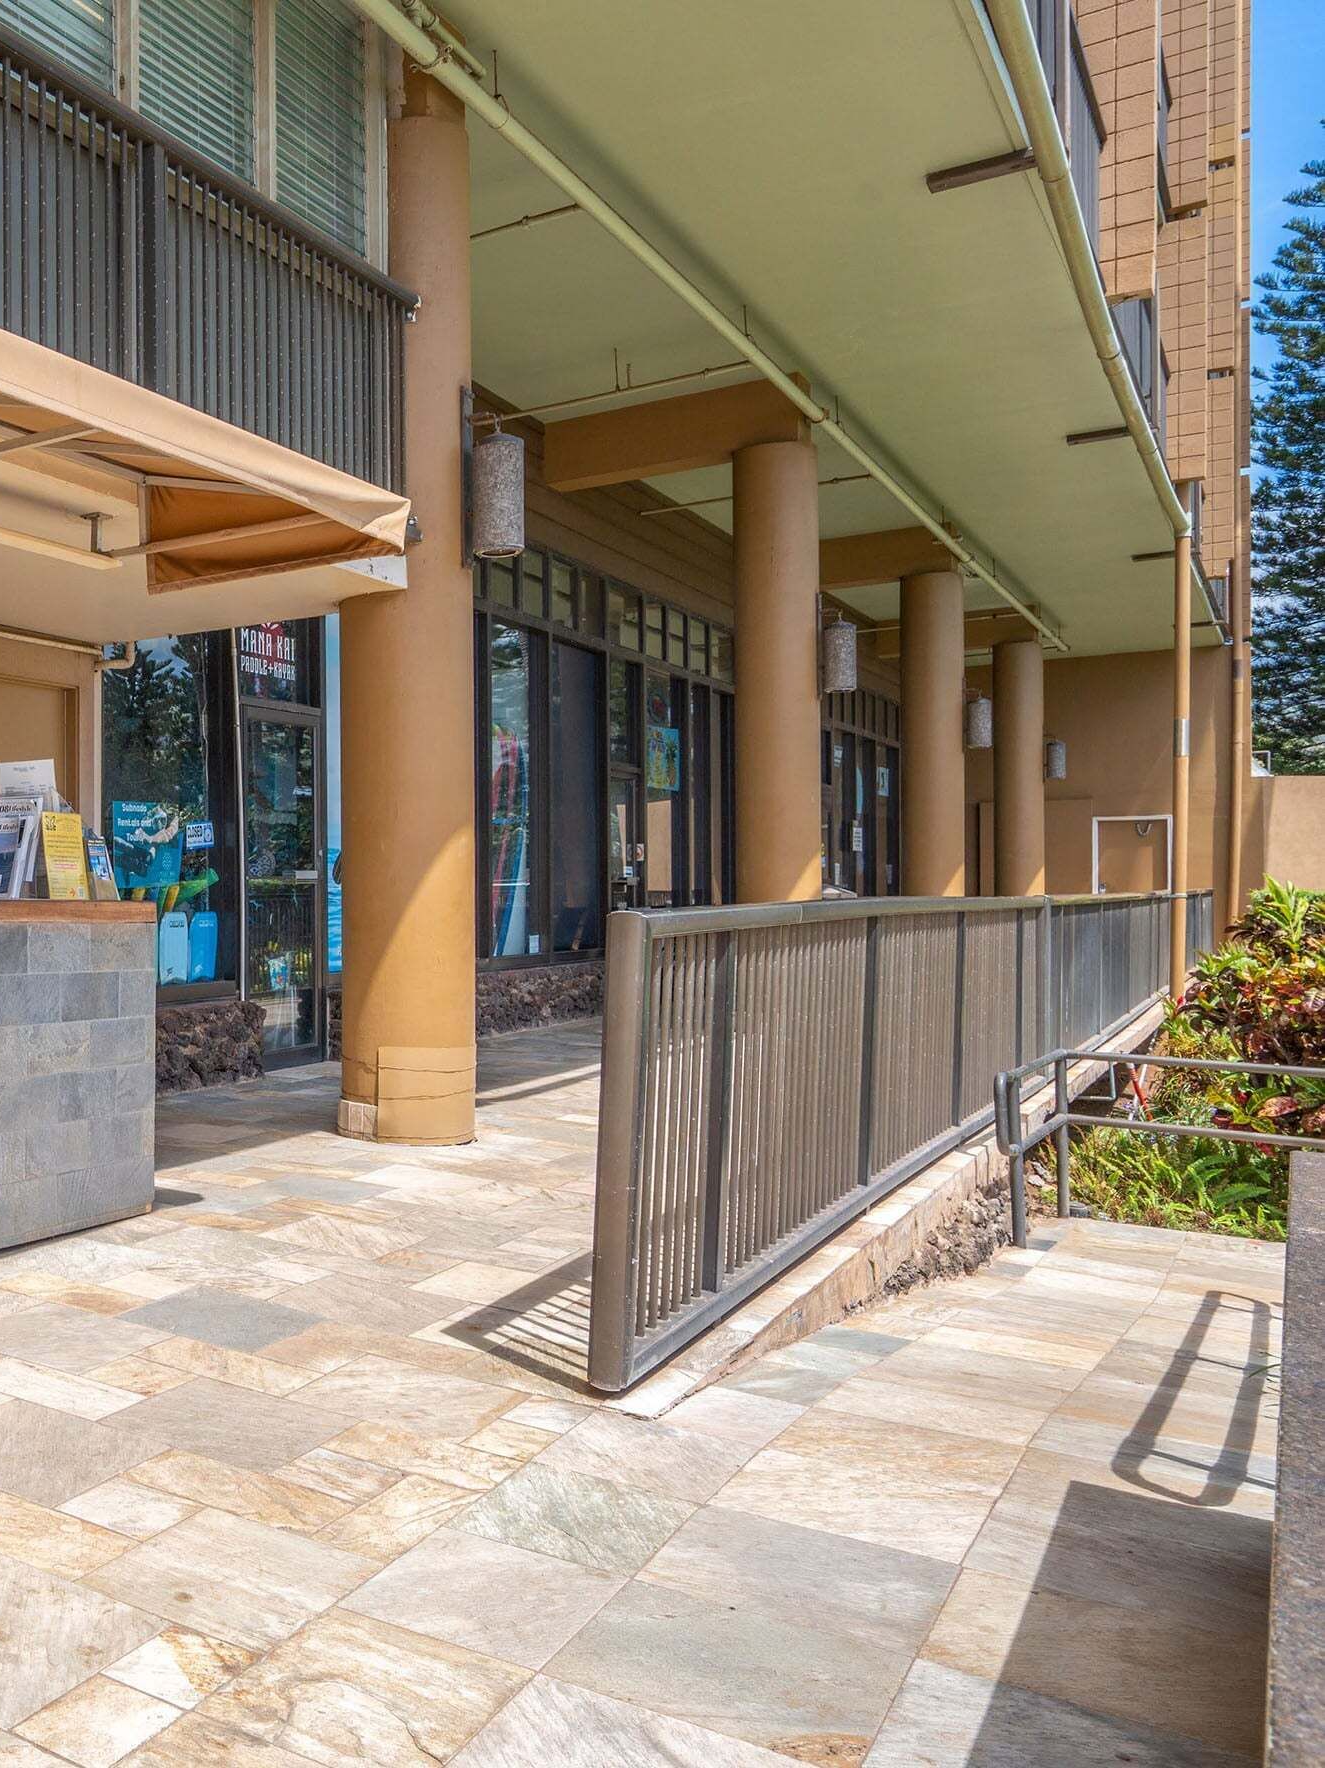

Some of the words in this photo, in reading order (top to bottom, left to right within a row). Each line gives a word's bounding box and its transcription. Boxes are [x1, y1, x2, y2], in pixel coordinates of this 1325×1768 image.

[240, 627, 272, 657] MANA
[276, 635, 296, 662] KAI
[117, 818, 140, 827] Rentals
[187, 825, 203, 839] CLOSED
